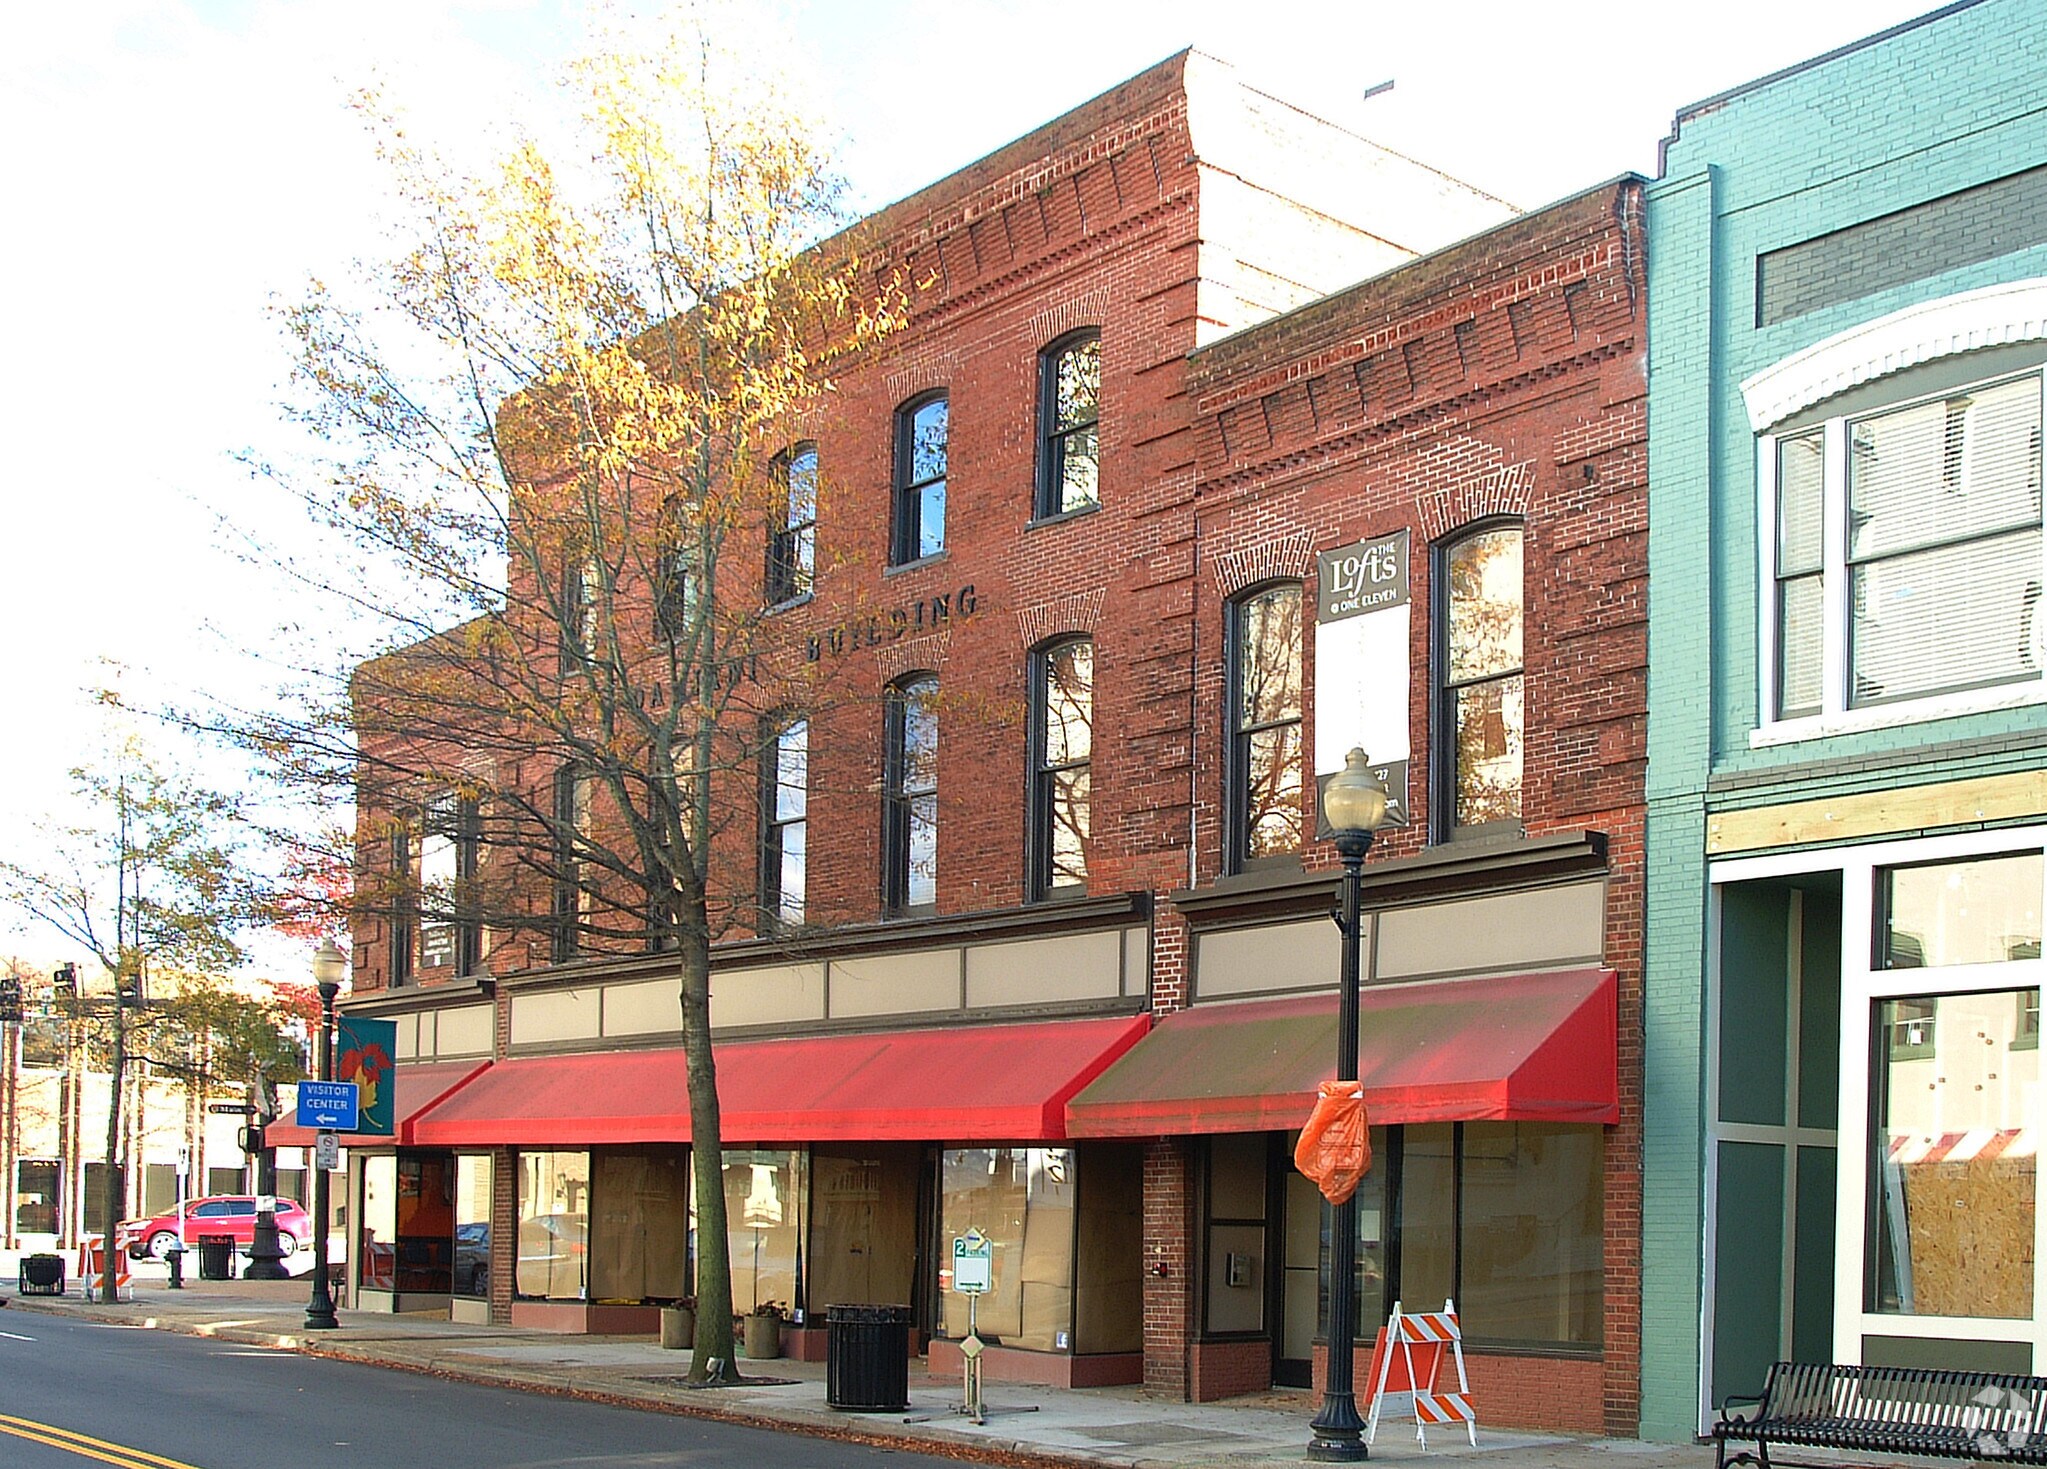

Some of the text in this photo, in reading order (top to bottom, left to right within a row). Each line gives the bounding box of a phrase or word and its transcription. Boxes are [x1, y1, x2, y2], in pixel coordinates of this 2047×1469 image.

[1378, 542, 1396, 555] THE
[1330, 547, 1397, 598] Lofts
[1340, 598, 1360, 611] ONE
[1362, 588, 1397, 606] ELEVEN
[306, 1085, 349, 1097] VISITOR
[306, 1098, 348, 1110] CENTER
[956, 1241, 965, 1257] 2
